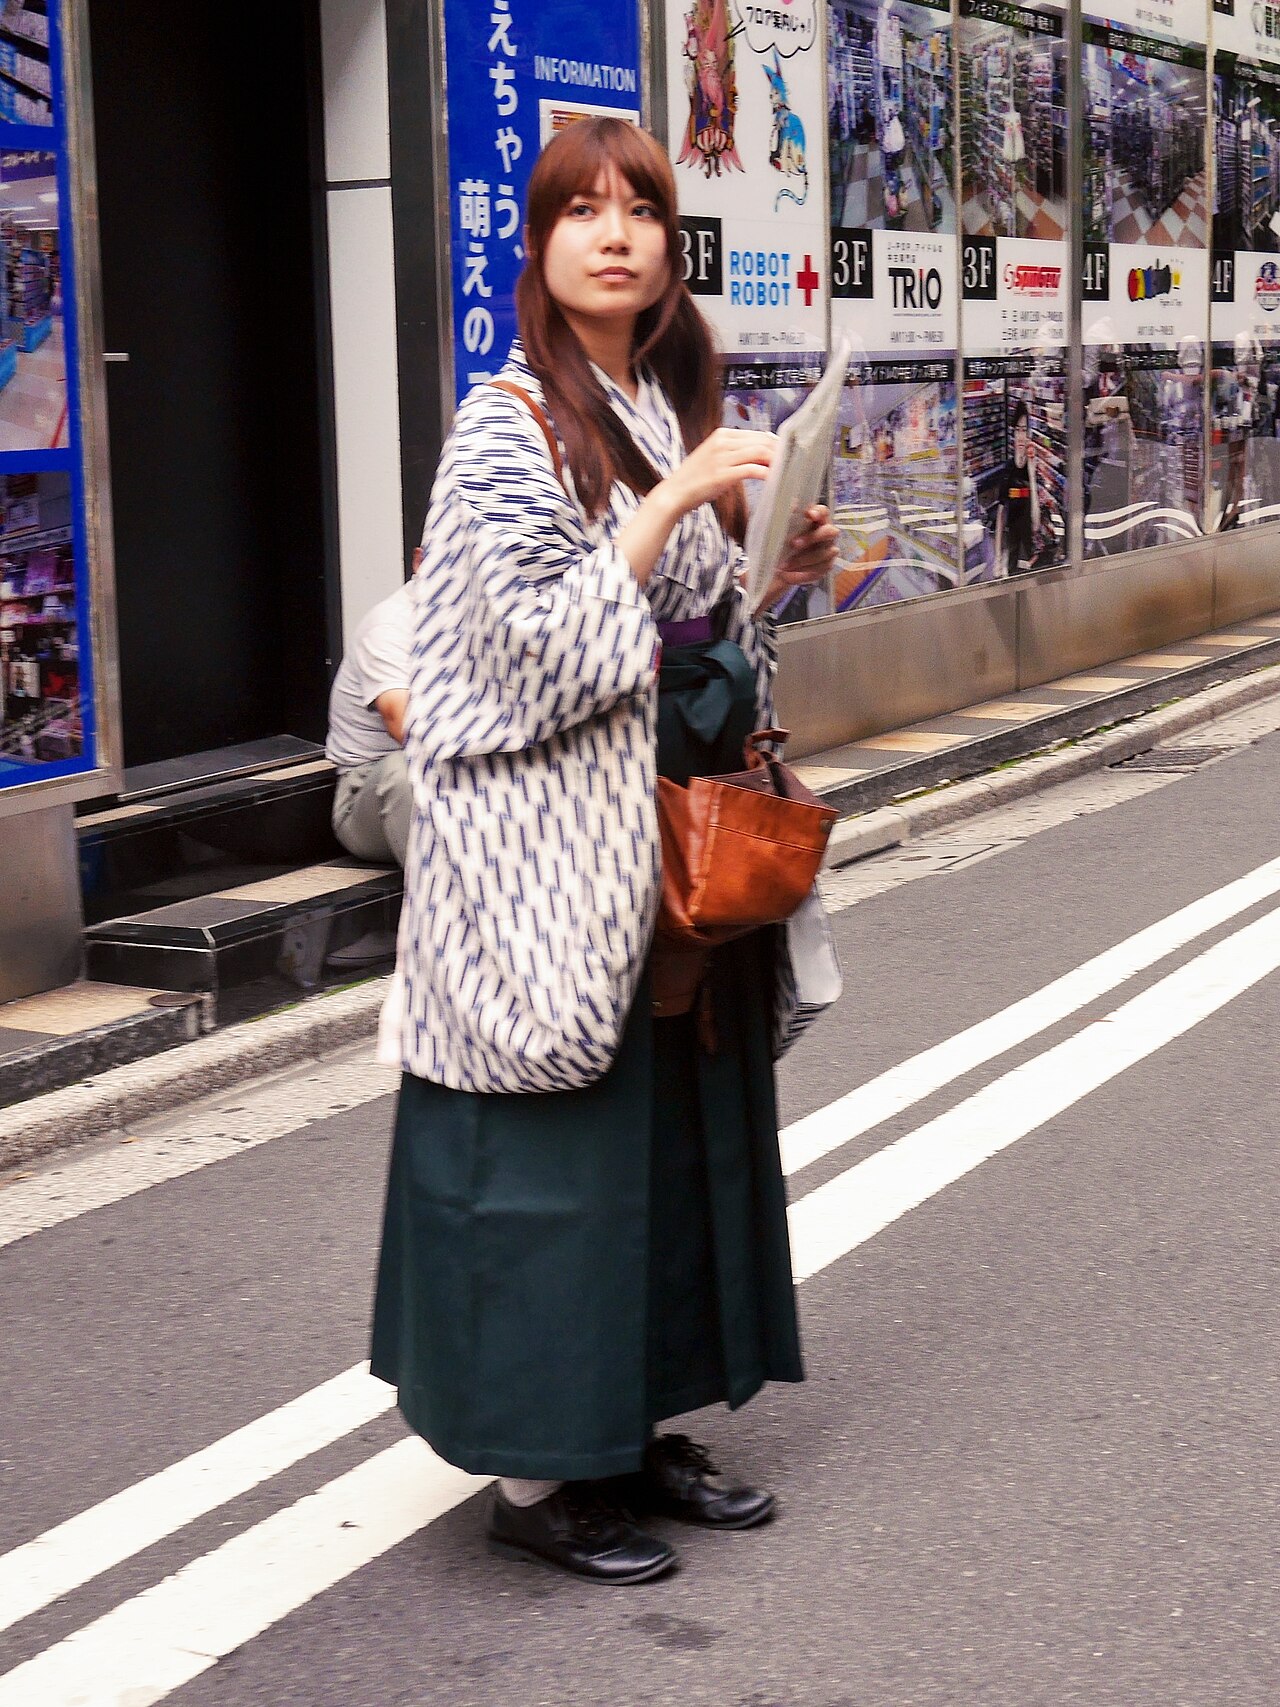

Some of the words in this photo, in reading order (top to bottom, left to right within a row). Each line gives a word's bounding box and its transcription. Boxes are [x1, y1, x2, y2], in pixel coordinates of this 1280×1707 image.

[534, 55, 636, 93] INFORMATION
[459, 178, 495, 385] 萌えの
[730, 251, 790, 277] ROBOT
[833, 240, 869, 286] 3F
[963, 247, 993, 288] 3F
[1081, 253, 1106, 290] 4F
[1212, 260, 1232, 293] 4F
[730, 281, 790, 307] ROBOT
[887, 267, 941, 309] TRIO
